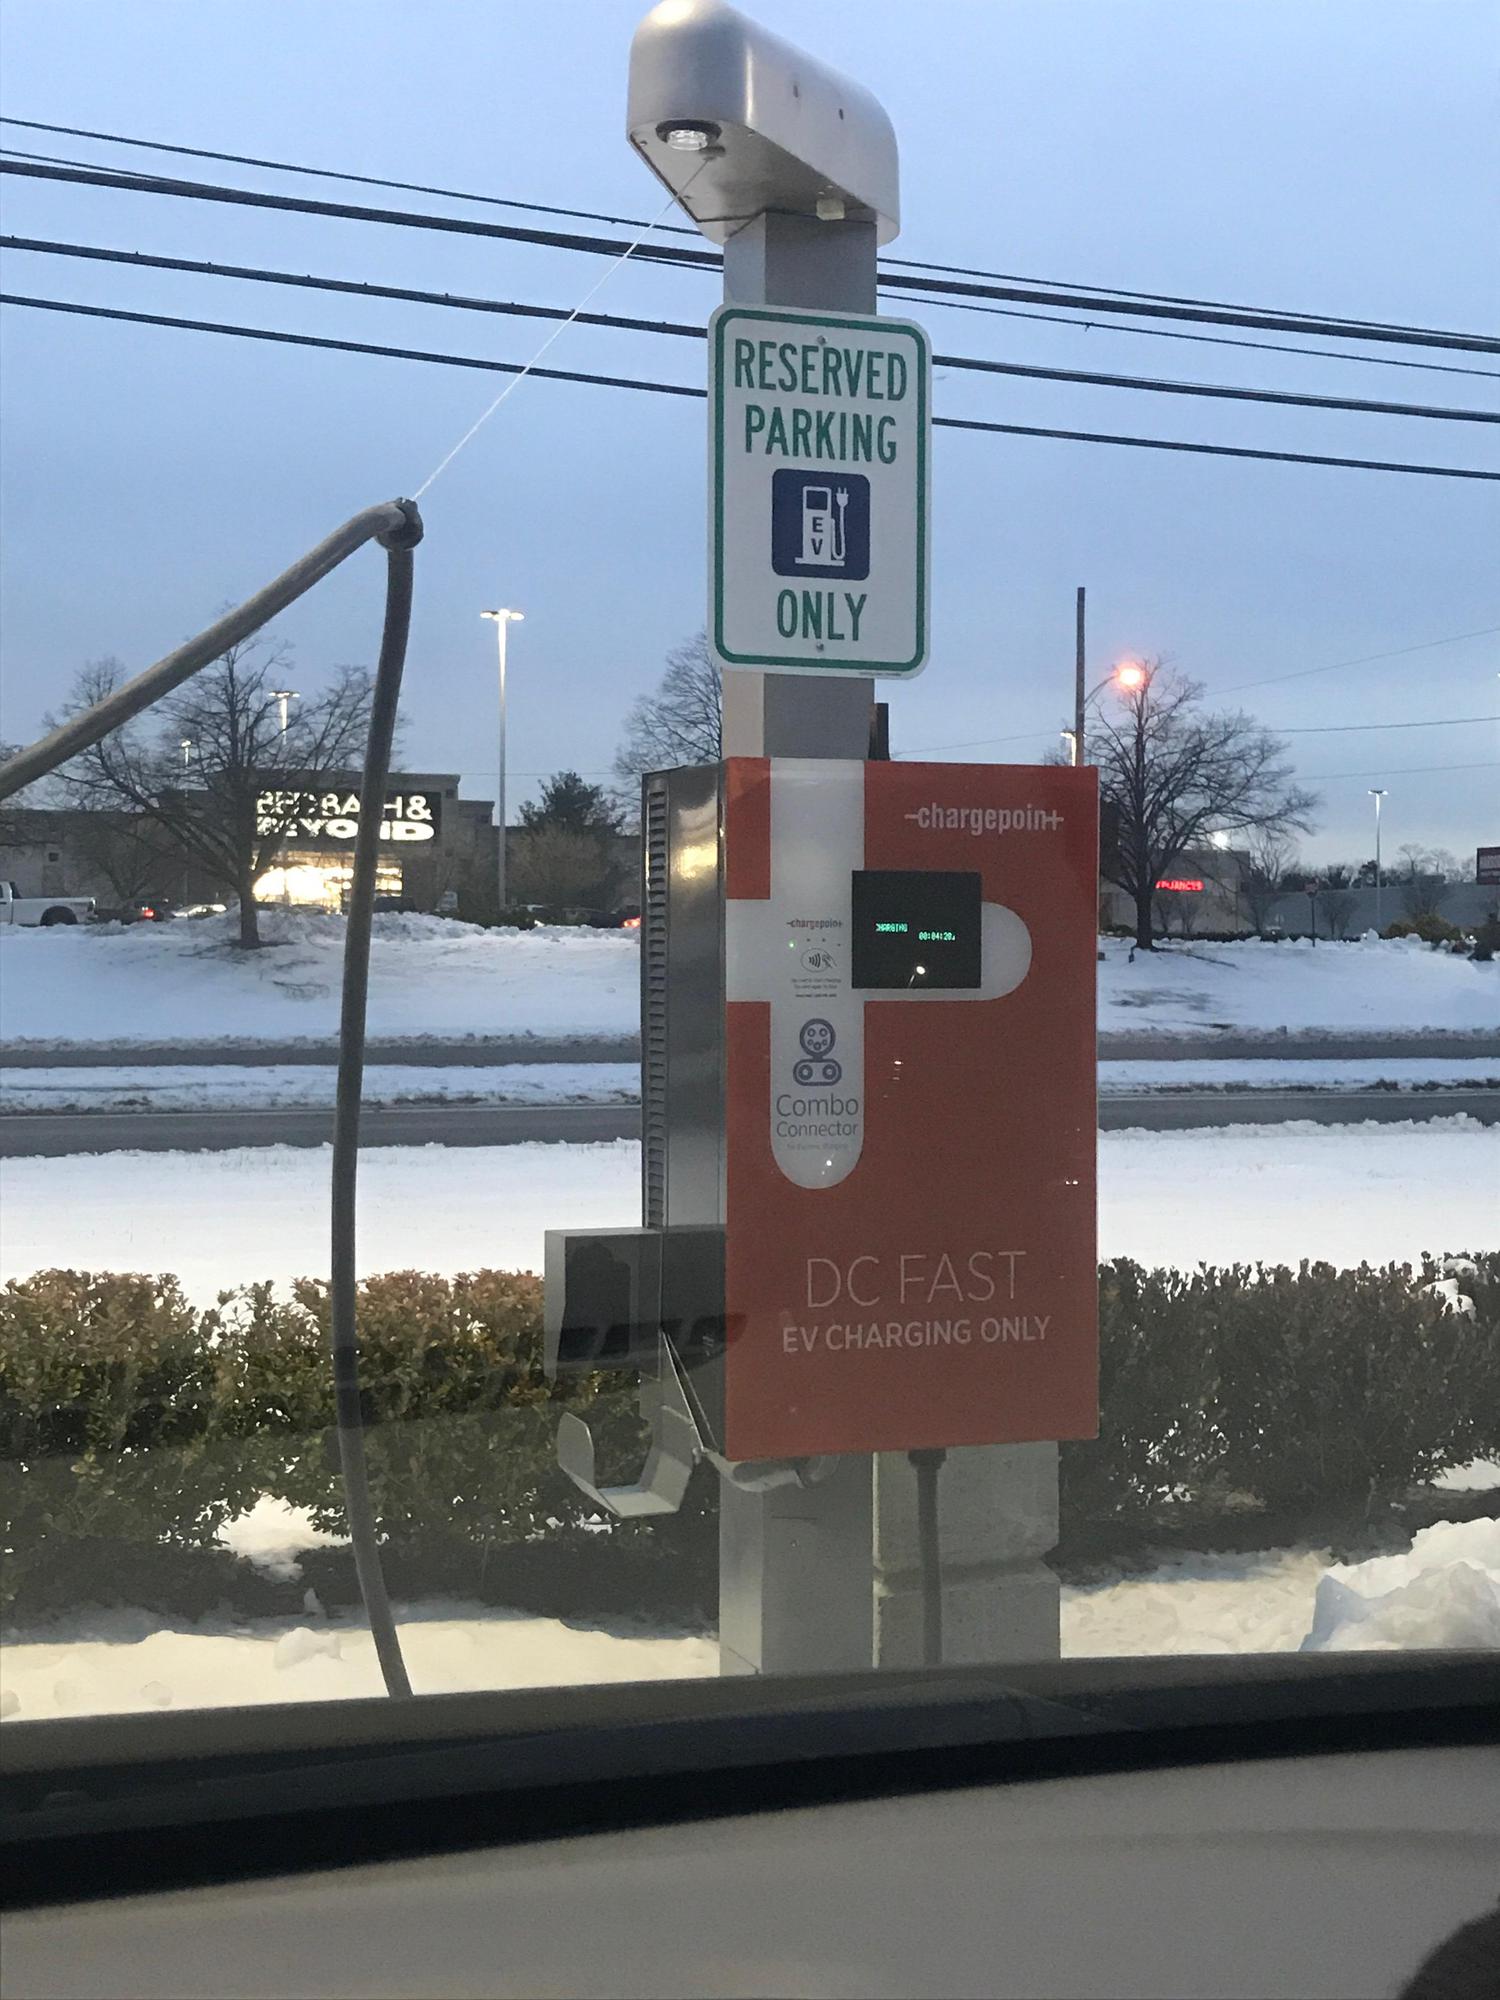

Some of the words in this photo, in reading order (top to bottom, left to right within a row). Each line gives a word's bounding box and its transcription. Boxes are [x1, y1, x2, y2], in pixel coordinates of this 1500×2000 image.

[734, 337, 907, 401] RESERVED
[745, 404, 897, 464] PARKING
[777, 589, 867, 641] ONLY
[321, 792, 402, 816] BAH
[406, 795, 433, 820] &
[776, 1092, 859, 1117] Combo
[776, 1120, 858, 1138] Connector
[807, 1255, 880, 1308] DC
[900, 1251, 1027, 1304] FAST
[783, 1326, 818, 1353] EV
[825, 1319, 972, 1351] CHARGING
[980, 1315, 1051, 1343] ONLY
